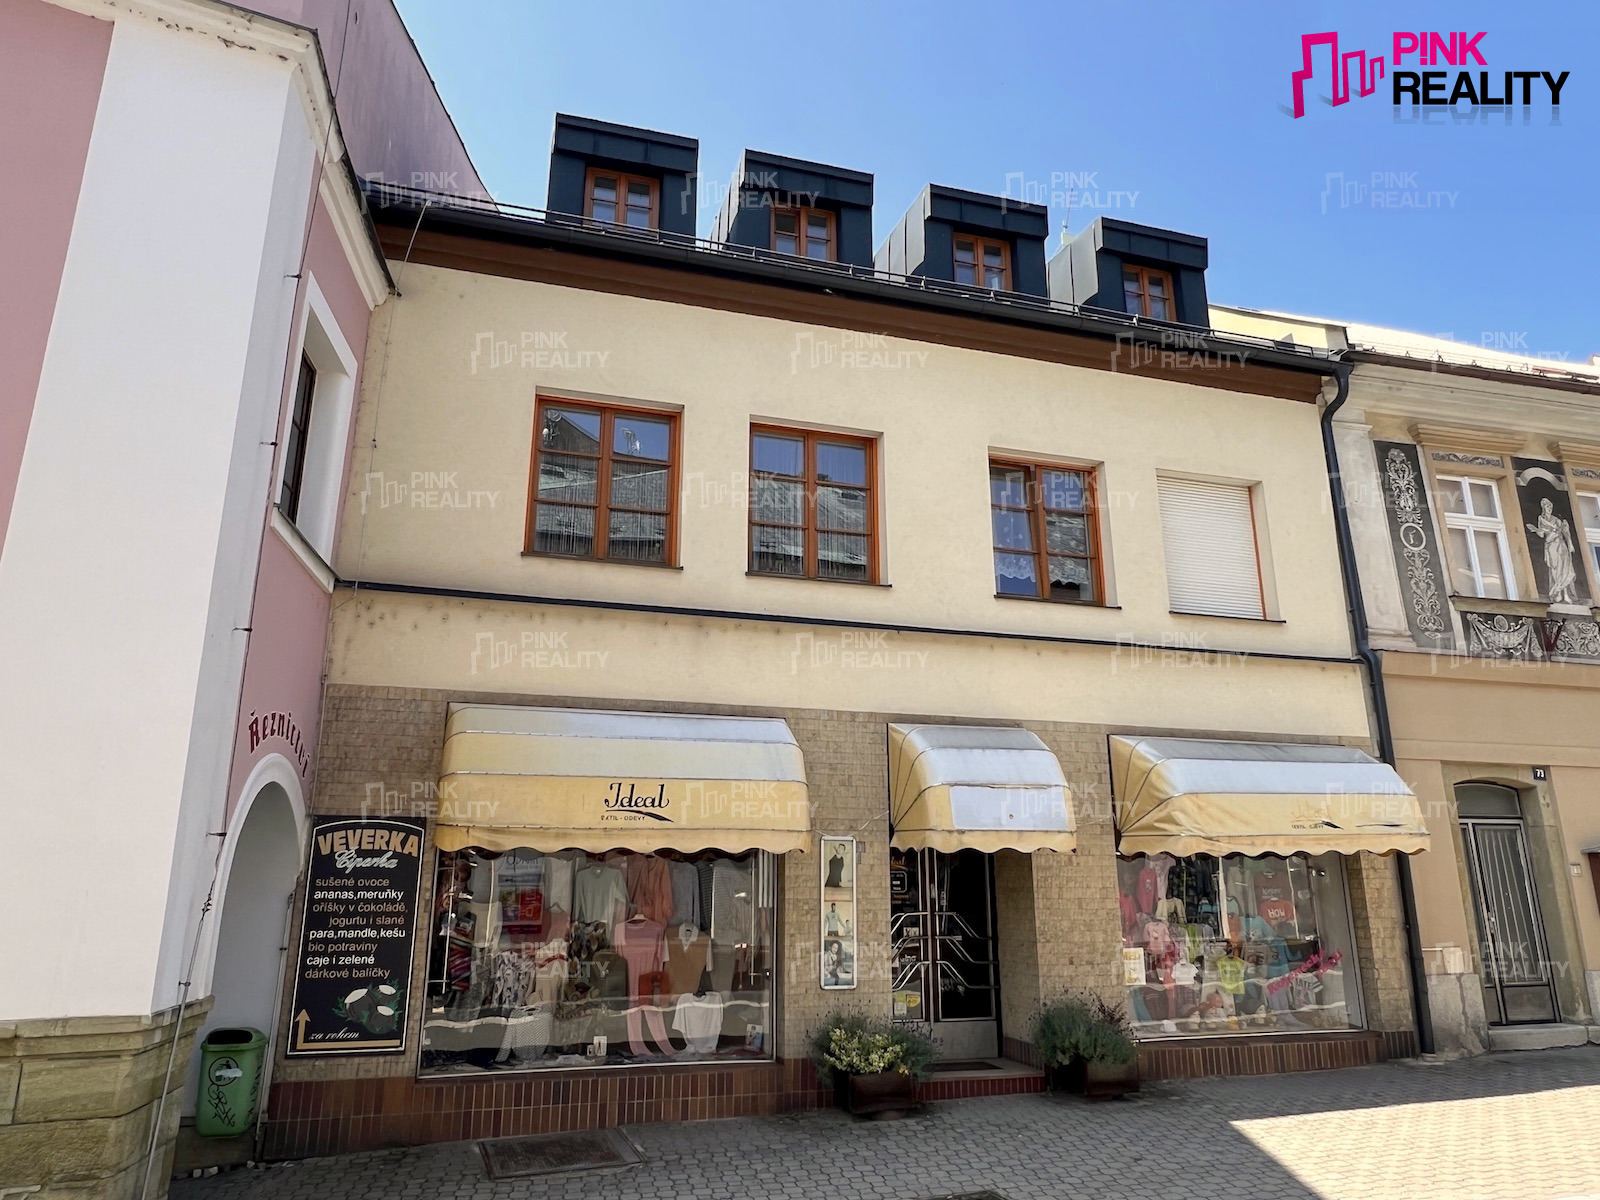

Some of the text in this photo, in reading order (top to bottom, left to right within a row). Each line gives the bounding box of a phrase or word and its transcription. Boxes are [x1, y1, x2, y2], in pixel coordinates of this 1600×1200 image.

[604, 782, 670, 808] Ideal
[317, 829, 419, 857] VEVERKA
[315, 877, 390, 887] sušené ovoce
[312, 902, 346, 914] oříšky
[348, 904, 355, 912] v
[328, 916, 366, 927] jogurtu
[375, 915, 405, 925] slané
[308, 942, 378, 953] bio potraviny
[338, 954, 375, 965] zelené
[304, 968, 391, 979] dárkové balíčky
